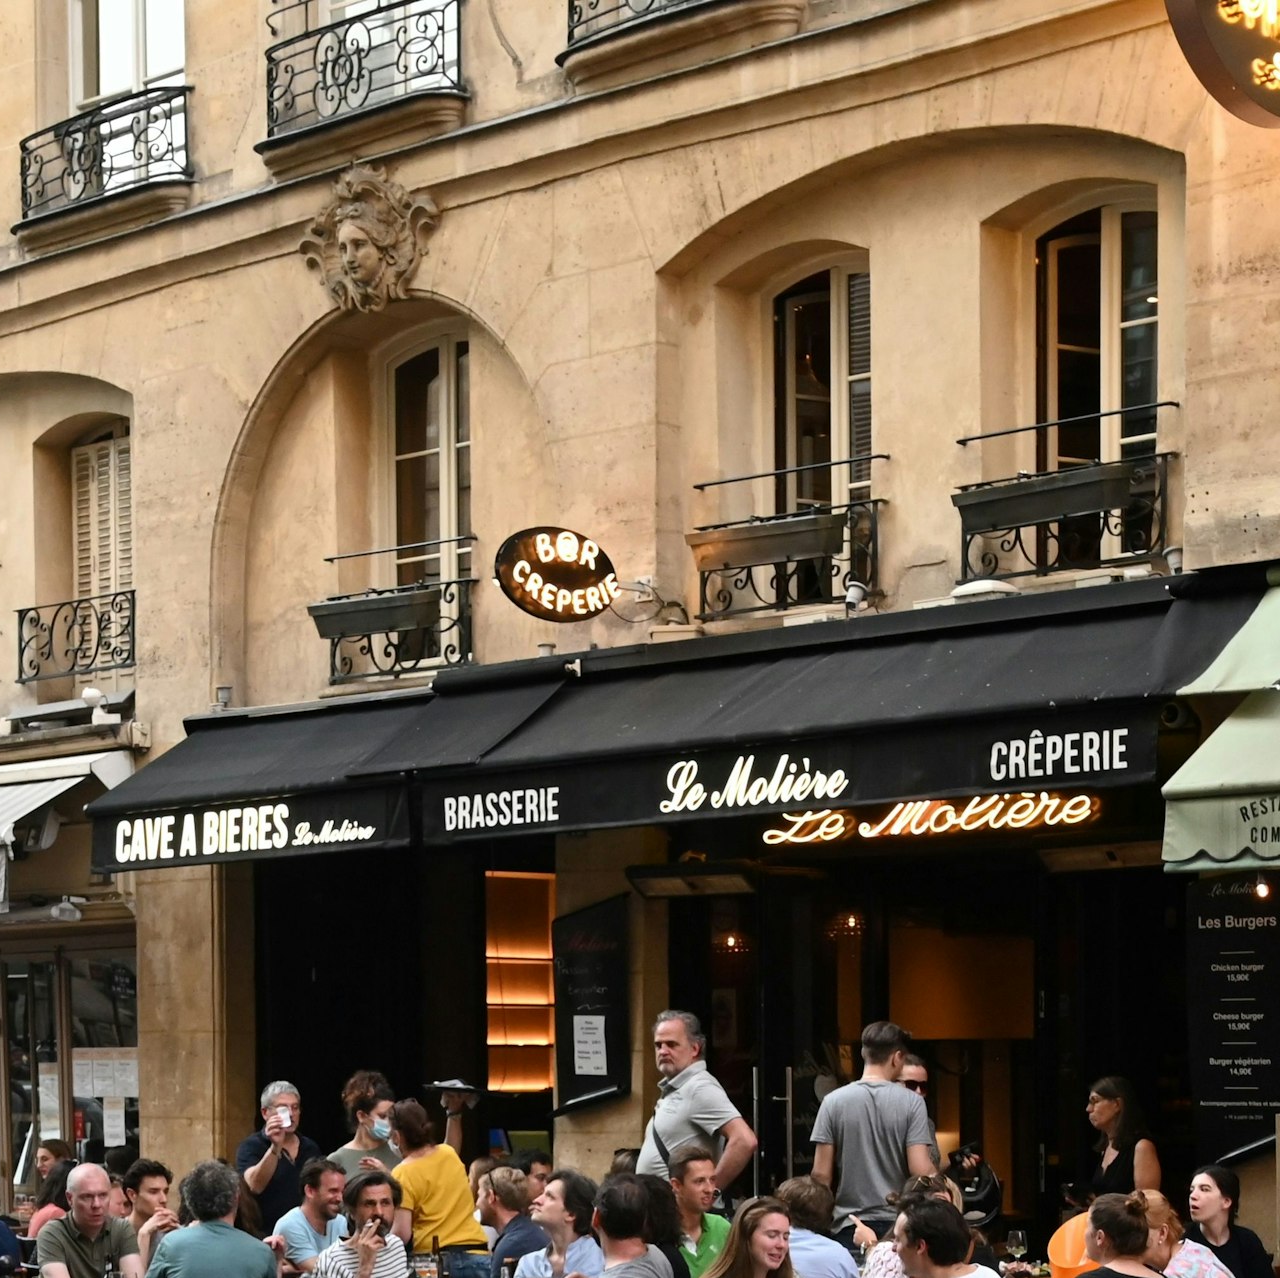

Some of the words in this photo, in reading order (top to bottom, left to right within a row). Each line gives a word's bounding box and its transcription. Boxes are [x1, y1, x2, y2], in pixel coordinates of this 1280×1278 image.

[513, 560, 622, 615] CREPERIE
[989, 728, 1129, 782] CRÊPERIE
[659, 759, 708, 814] Le
[710, 752, 849, 810] Molière
[444, 786, 560, 831] BRASSERIE
[762, 808, 846, 845] Le
[858, 790, 1093, 839] Molière
[115, 815, 175, 863] CAVE
[179, 813, 197, 858] A
[202, 803, 290, 856] BIERES
[292, 821, 313, 846] Le
[313, 818, 377, 845] Molière
[1198, 915, 1221, 929] Les
[1225, 915, 1277, 930] Burgers
[1210, 963, 1240, 972] Chicken
[1241, 963, 1265, 972] burger
[1213, 1012, 1239, 1020] Cheese
[1241, 1012, 1264, 1021] burger
[1209, 1057, 1233, 1067] Burger
